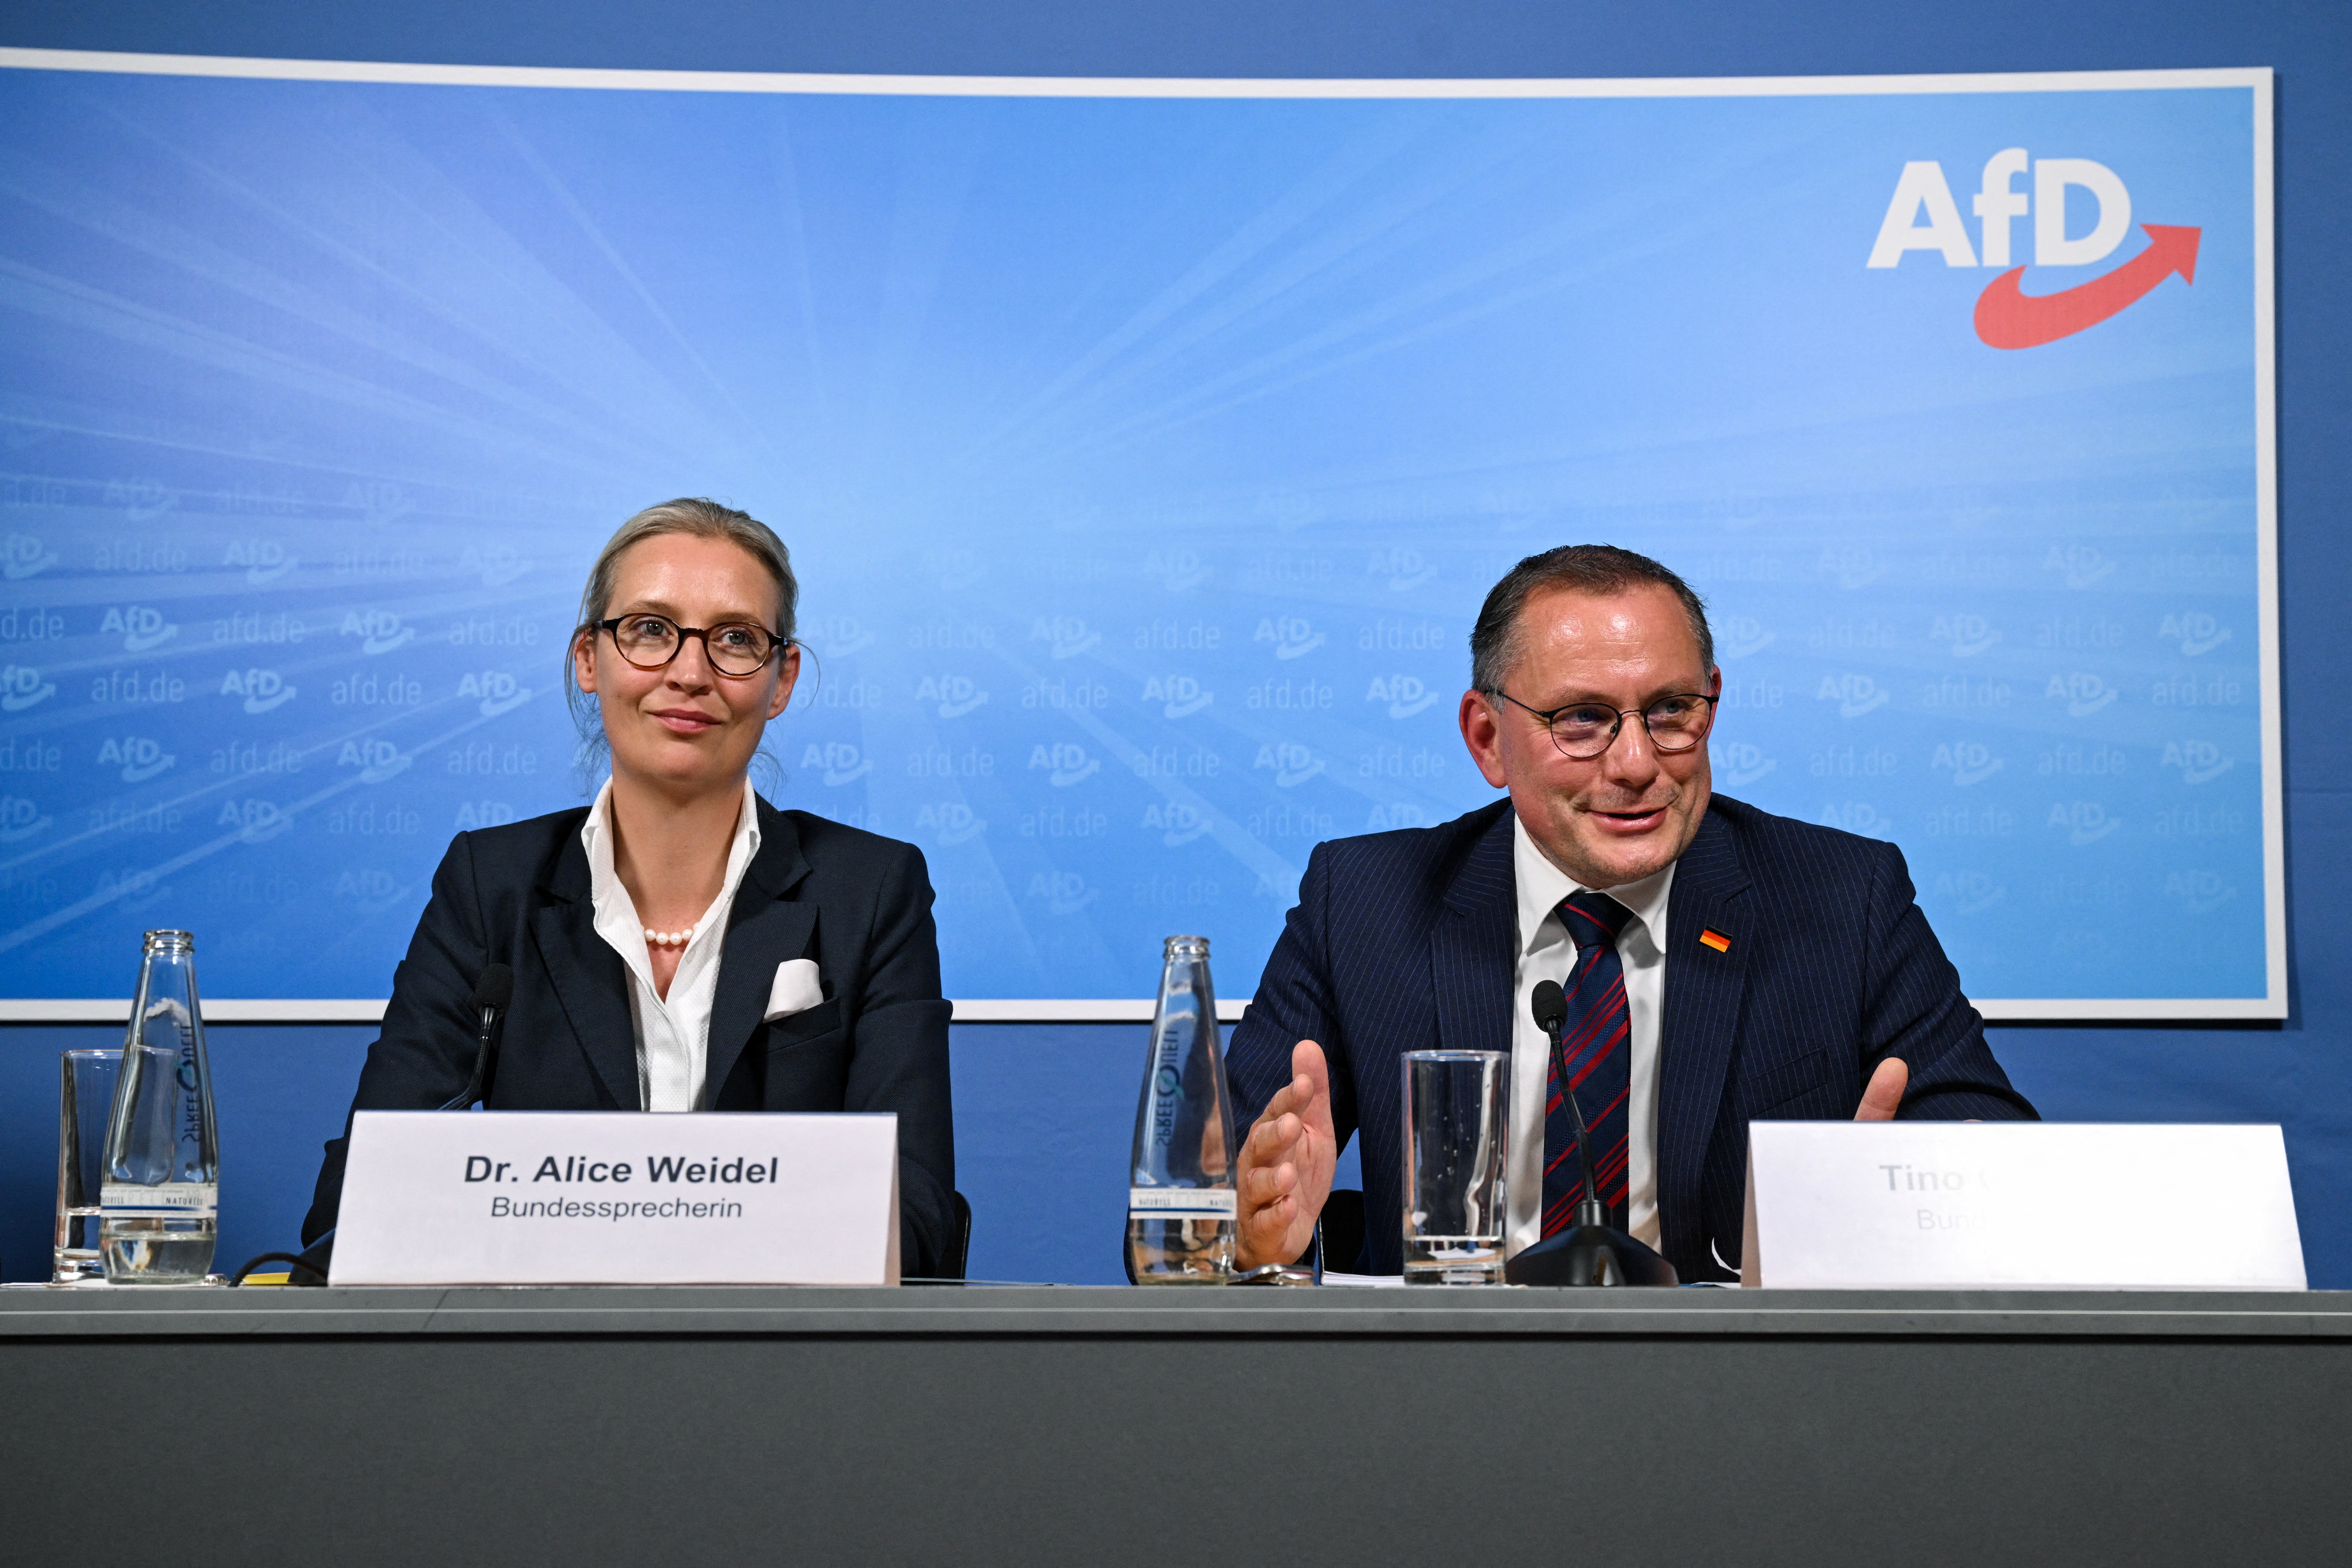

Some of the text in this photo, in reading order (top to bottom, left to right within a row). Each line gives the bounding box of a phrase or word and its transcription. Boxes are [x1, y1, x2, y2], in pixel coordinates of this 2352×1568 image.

[1866, 148, 2132, 268] AfD
[0, 533, 42, 561] fD
[93, 539, 187, 572] afd.de
[223, 538, 284, 566] AfD
[1, 607, 65, 641] d.de
[100, 605, 163, 633] AfD
[212, 610, 306, 643] afd.de
[339, 610, 401, 637] AfD
[449, 614, 539, 646] afd.de
[907, 617, 995, 649] afd.de
[1030, 615, 1086, 641] AfD
[1254, 615, 1311, 642] AfD
[1929, 613, 1988, 639] AfD
[2036, 616, 2124, 647] afd.de
[2158, 611, 2216, 638] AfD
[1134, 618, 1221, 650] afd.de
[1358, 618, 1445, 650] afd.de
[0, 665, 40, 693] fD
[91, 670, 186, 703] afd.de
[220, 668, 282, 696] AfD
[331, 673, 422, 705] afd.de
[457, 670, 517, 698] AfD
[915, 673, 974, 701] AfD
[1022, 676, 1108, 709] afd.de
[1141, 675, 1199, 701] AfD
[1246, 677, 1333, 709] afd.de
[1366, 674, 1424, 702] AfD
[1725, 677, 1784, 708] d.de
[1816, 673, 1875, 701] AfD
[1923, 675, 2011, 709] afd.de
[2046, 672, 2103, 698] AfD
[2152, 674, 2241, 706] afd.de
[0, 737, 61, 772] d.de
[96, 737, 160, 765] AfD
[210, 740, 303, 774] afd.de
[336, 738, 398, 766] AfD
[446, 742, 537, 775] afd.de
[800, 742, 859, 769] AfD
[906, 745, 994, 777] afd.de
[1027, 742, 1086, 770] AfD
[1133, 746, 1221, 778] afd.de
[1254, 742, 1311, 770] AfD
[1358, 746, 1446, 778] afd.de
[1809, 745, 1897, 777] afd.de
[1930, 741, 1989, 769] AfD
[2037, 743, 2126, 775] afd.de
[2160, 740, 2219, 767] AfD
[0, 795, 37, 825] fD
[216, 799, 280, 826] AfD
[328, 802, 421, 835] afd.de
[454, 800, 514, 827] AfD
[915, 802, 973, 829] AfD
[1020, 805, 1107, 837] afd.de
[1141, 802, 1199, 829] AfD
[1248, 805, 1332, 837] afd.de
[1367, 802, 1423, 828] AfD
[1820, 801, 1877, 829] AfD
[1924, 805, 2013, 838] afd.de
[2046, 801, 2104, 827] AfD
[2154, 802, 2244, 836] afd.de
[332, 870, 395, 896] AfD
[1027, 871, 1084, 898] AfD
[465, 1156, 779, 1183] Dr. Alice Weidel
[1879, 1165, 1964, 1191] Tino
[491, 1197, 743, 1222] Bundessprecherin
